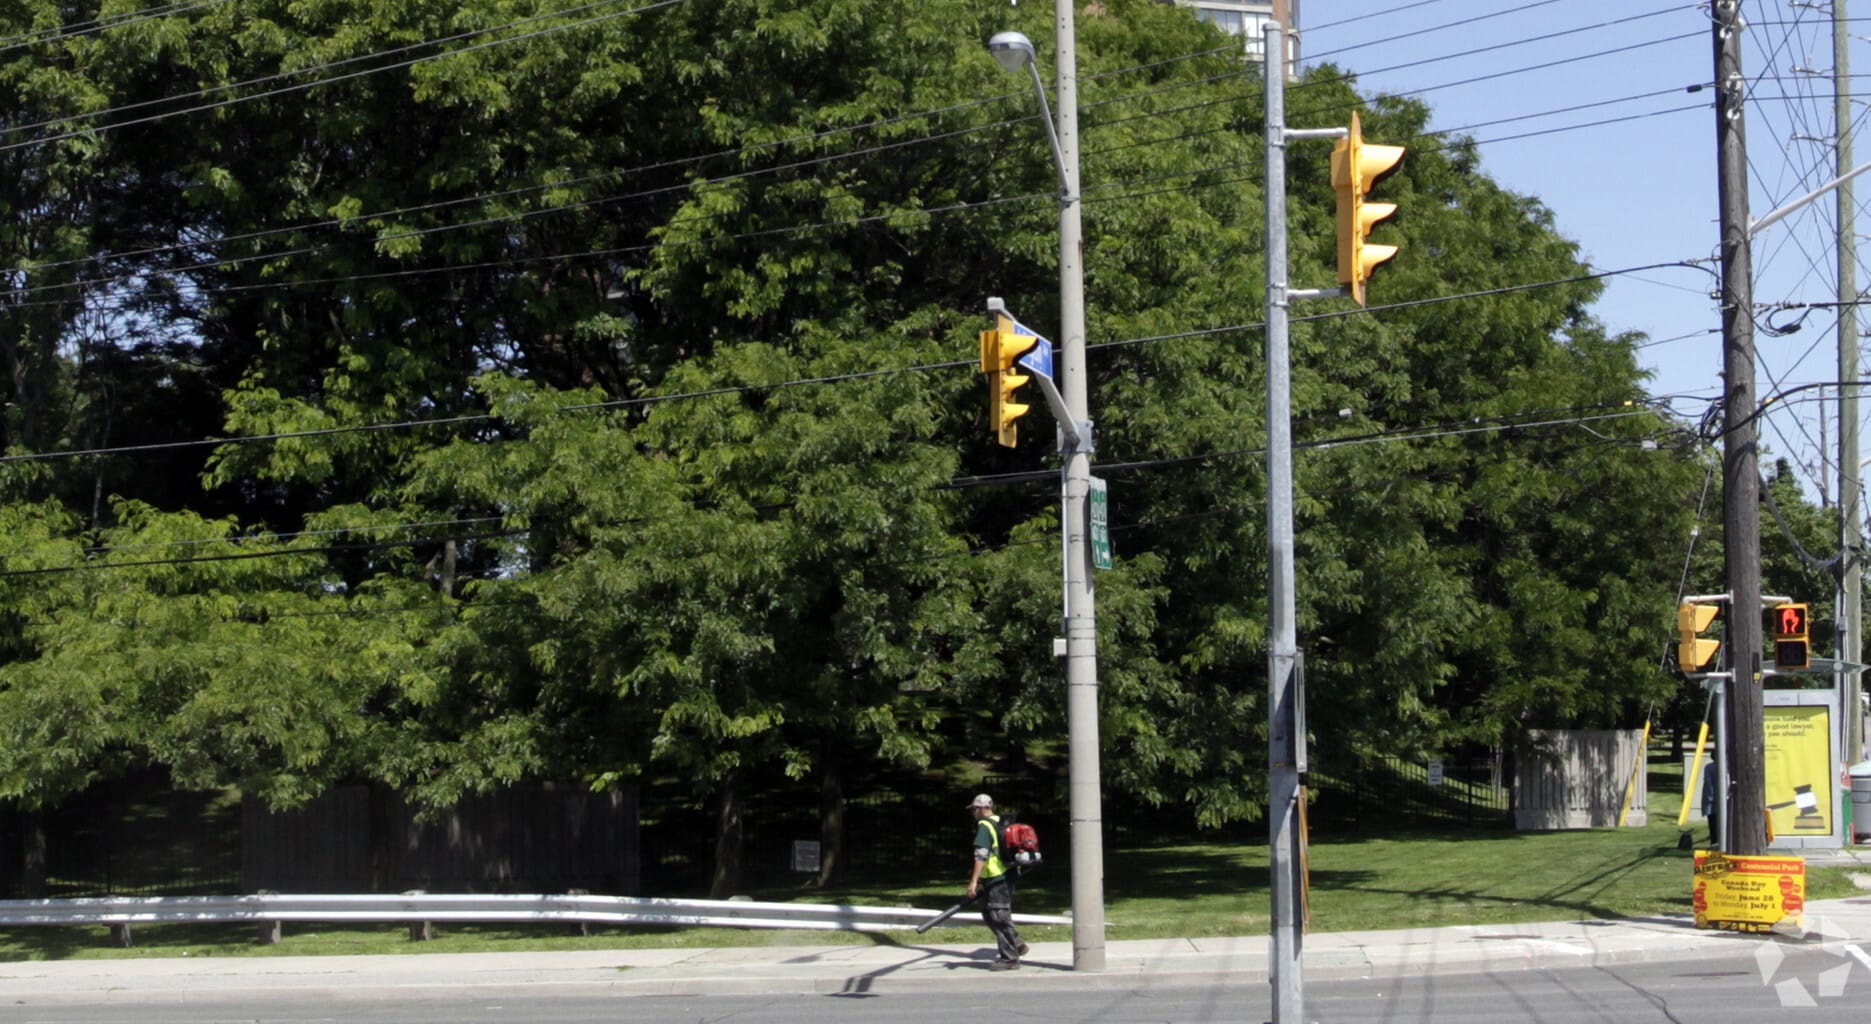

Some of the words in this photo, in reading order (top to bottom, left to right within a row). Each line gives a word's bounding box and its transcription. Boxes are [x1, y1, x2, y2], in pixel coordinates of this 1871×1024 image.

[1782, 863, 1799, 871] Park
[1739, 894, 1760, 902] June
[1750, 903, 1768, 911] July
